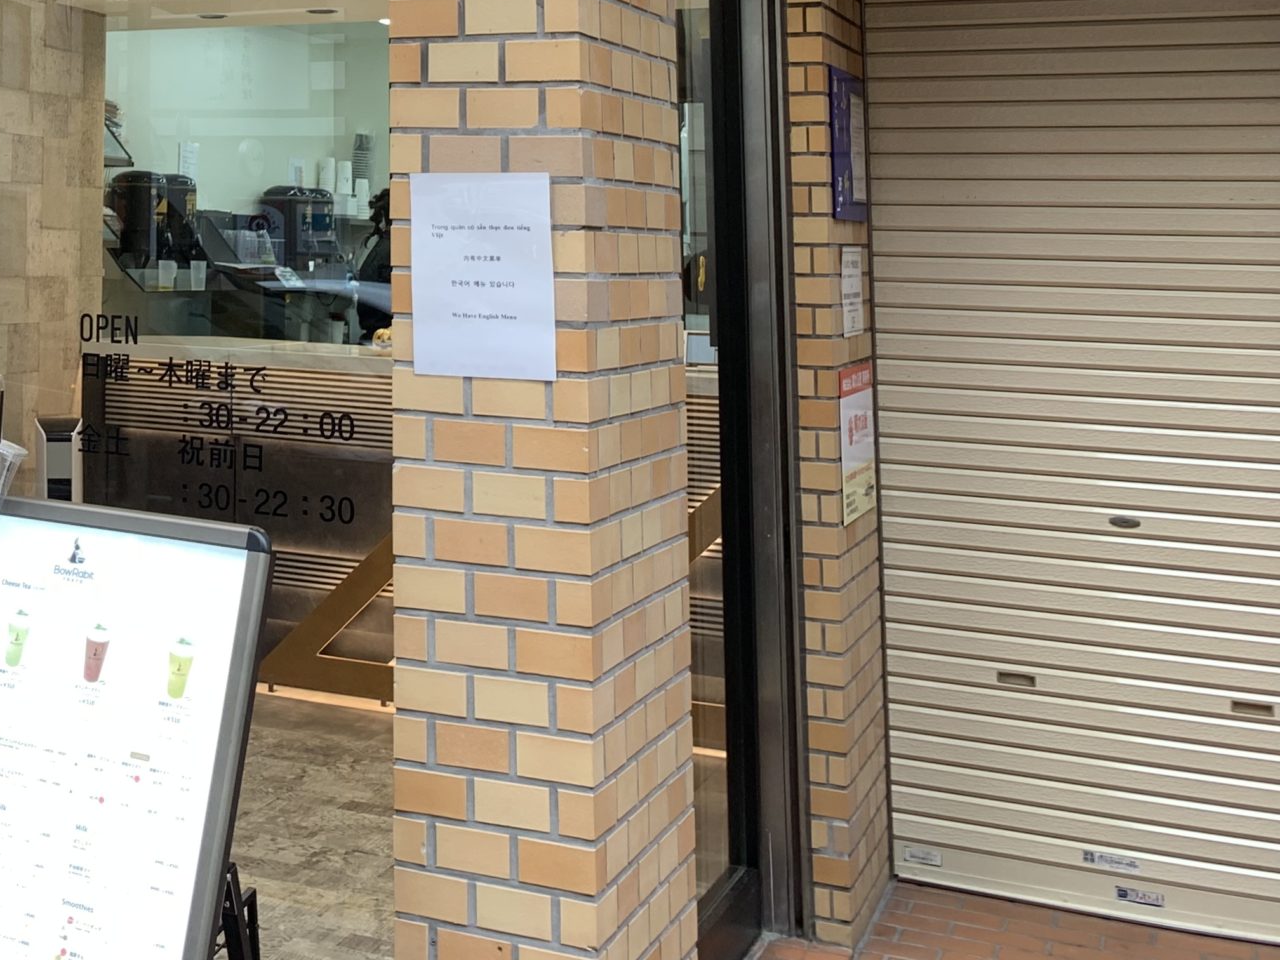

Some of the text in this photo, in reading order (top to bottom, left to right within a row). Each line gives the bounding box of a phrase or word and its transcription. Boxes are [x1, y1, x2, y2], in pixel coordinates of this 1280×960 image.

[80, 313, 138, 345] OPEN
[177, 434, 264, 472] 祝前日
[53, 565, 95, 581] BowRabit
[61, 898, 94, 914] Smoothies
